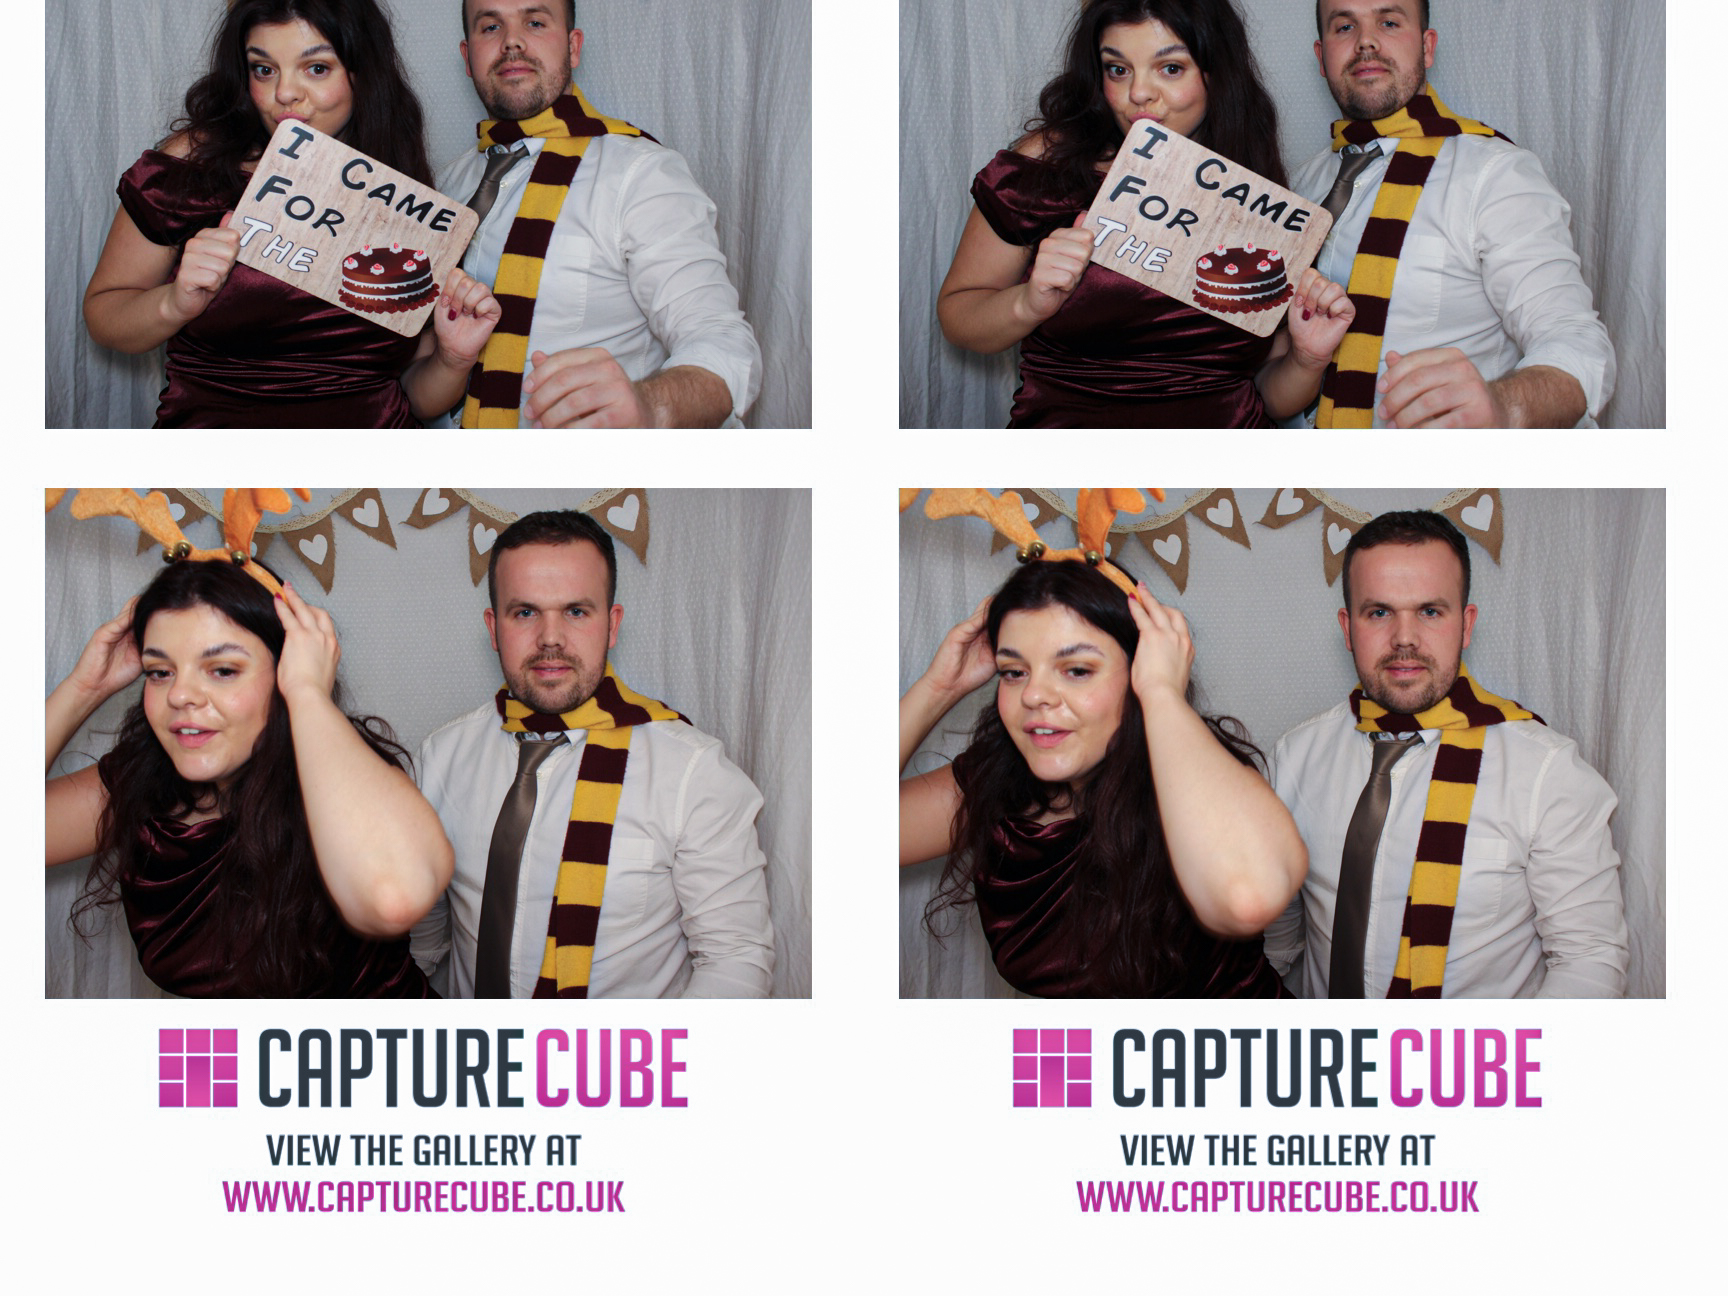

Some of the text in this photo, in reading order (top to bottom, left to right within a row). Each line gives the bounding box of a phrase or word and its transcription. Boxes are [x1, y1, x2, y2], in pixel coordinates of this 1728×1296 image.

[255, 175, 345, 237] FOR
[278, 126, 457, 232] I CAME
[1109, 175, 1199, 237] FOR
[1132, 126, 1311, 232] I CAME
[240, 216, 318, 272] THE
[1094, 216, 1172, 272] THE
